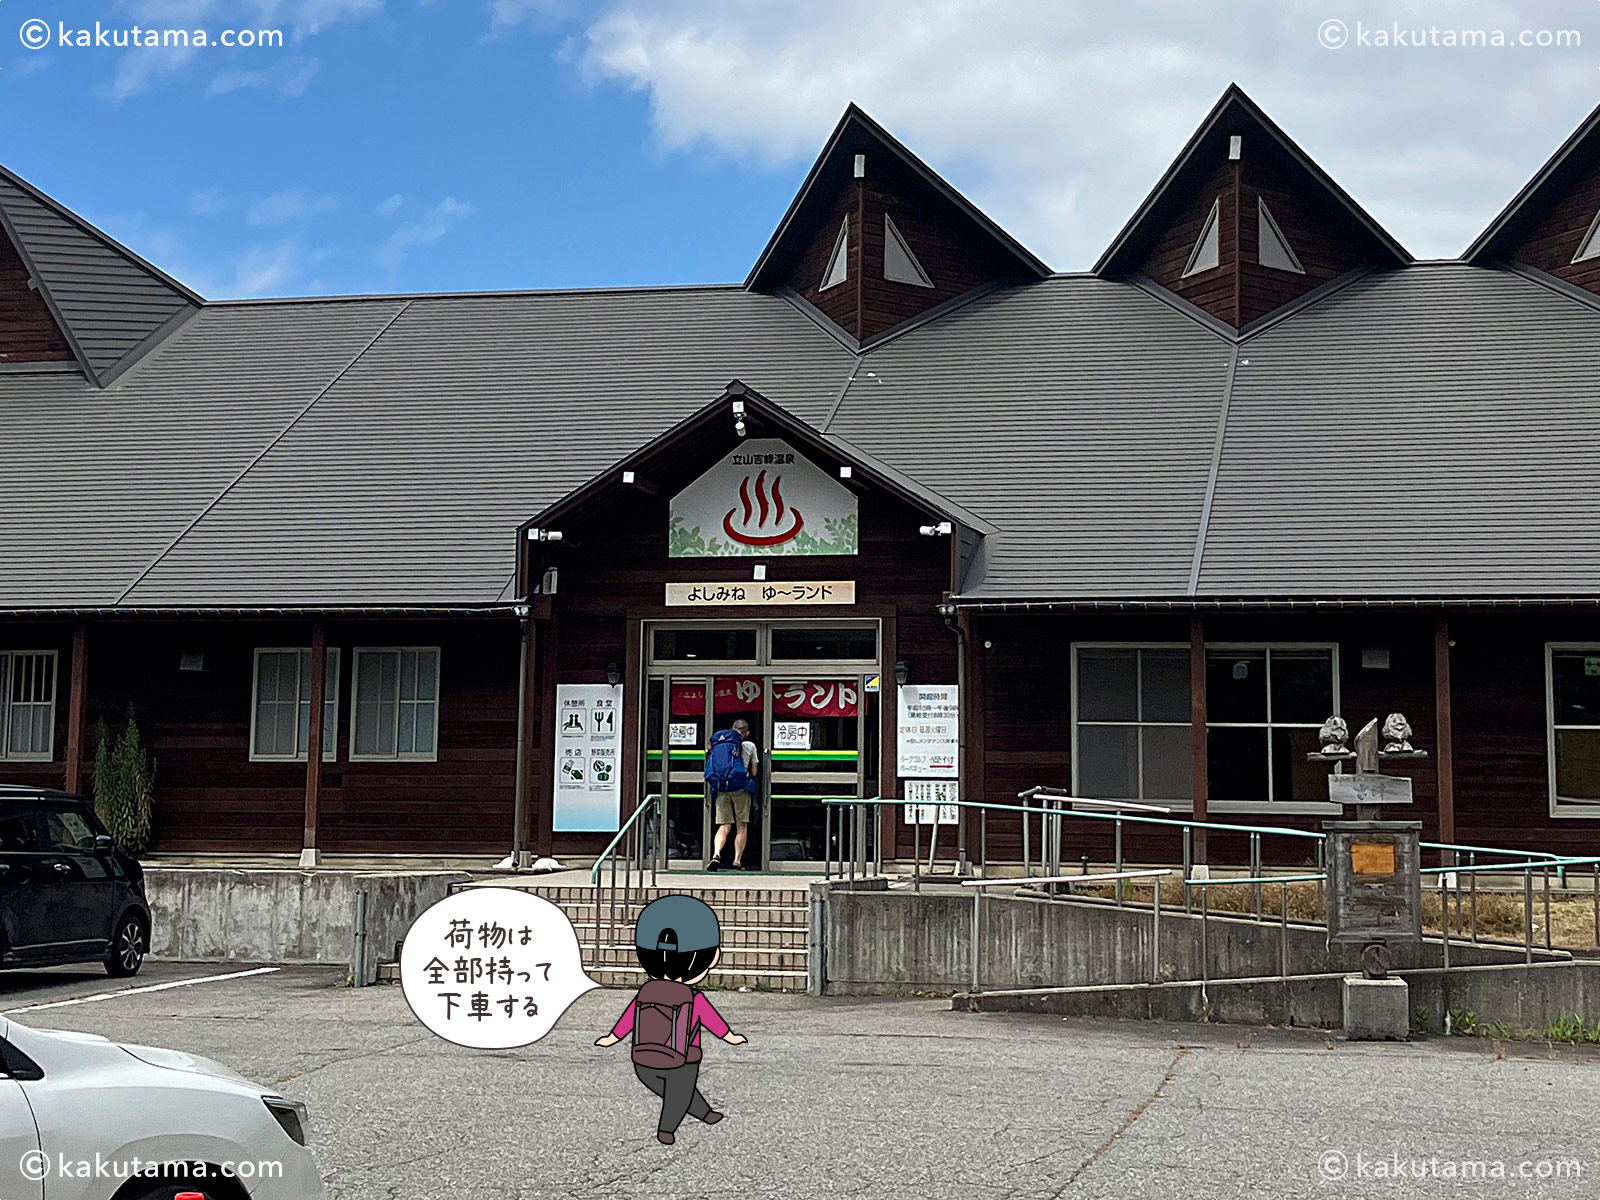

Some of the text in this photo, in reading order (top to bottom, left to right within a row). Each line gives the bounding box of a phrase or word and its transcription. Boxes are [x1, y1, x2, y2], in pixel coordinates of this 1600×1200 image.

[732, 454, 795, 465] 立山吉峰温泉
[687, 586, 746, 601] よしみね
[777, 724, 807, 741] 冷房中
[929, 755, 955, 764] 受付
